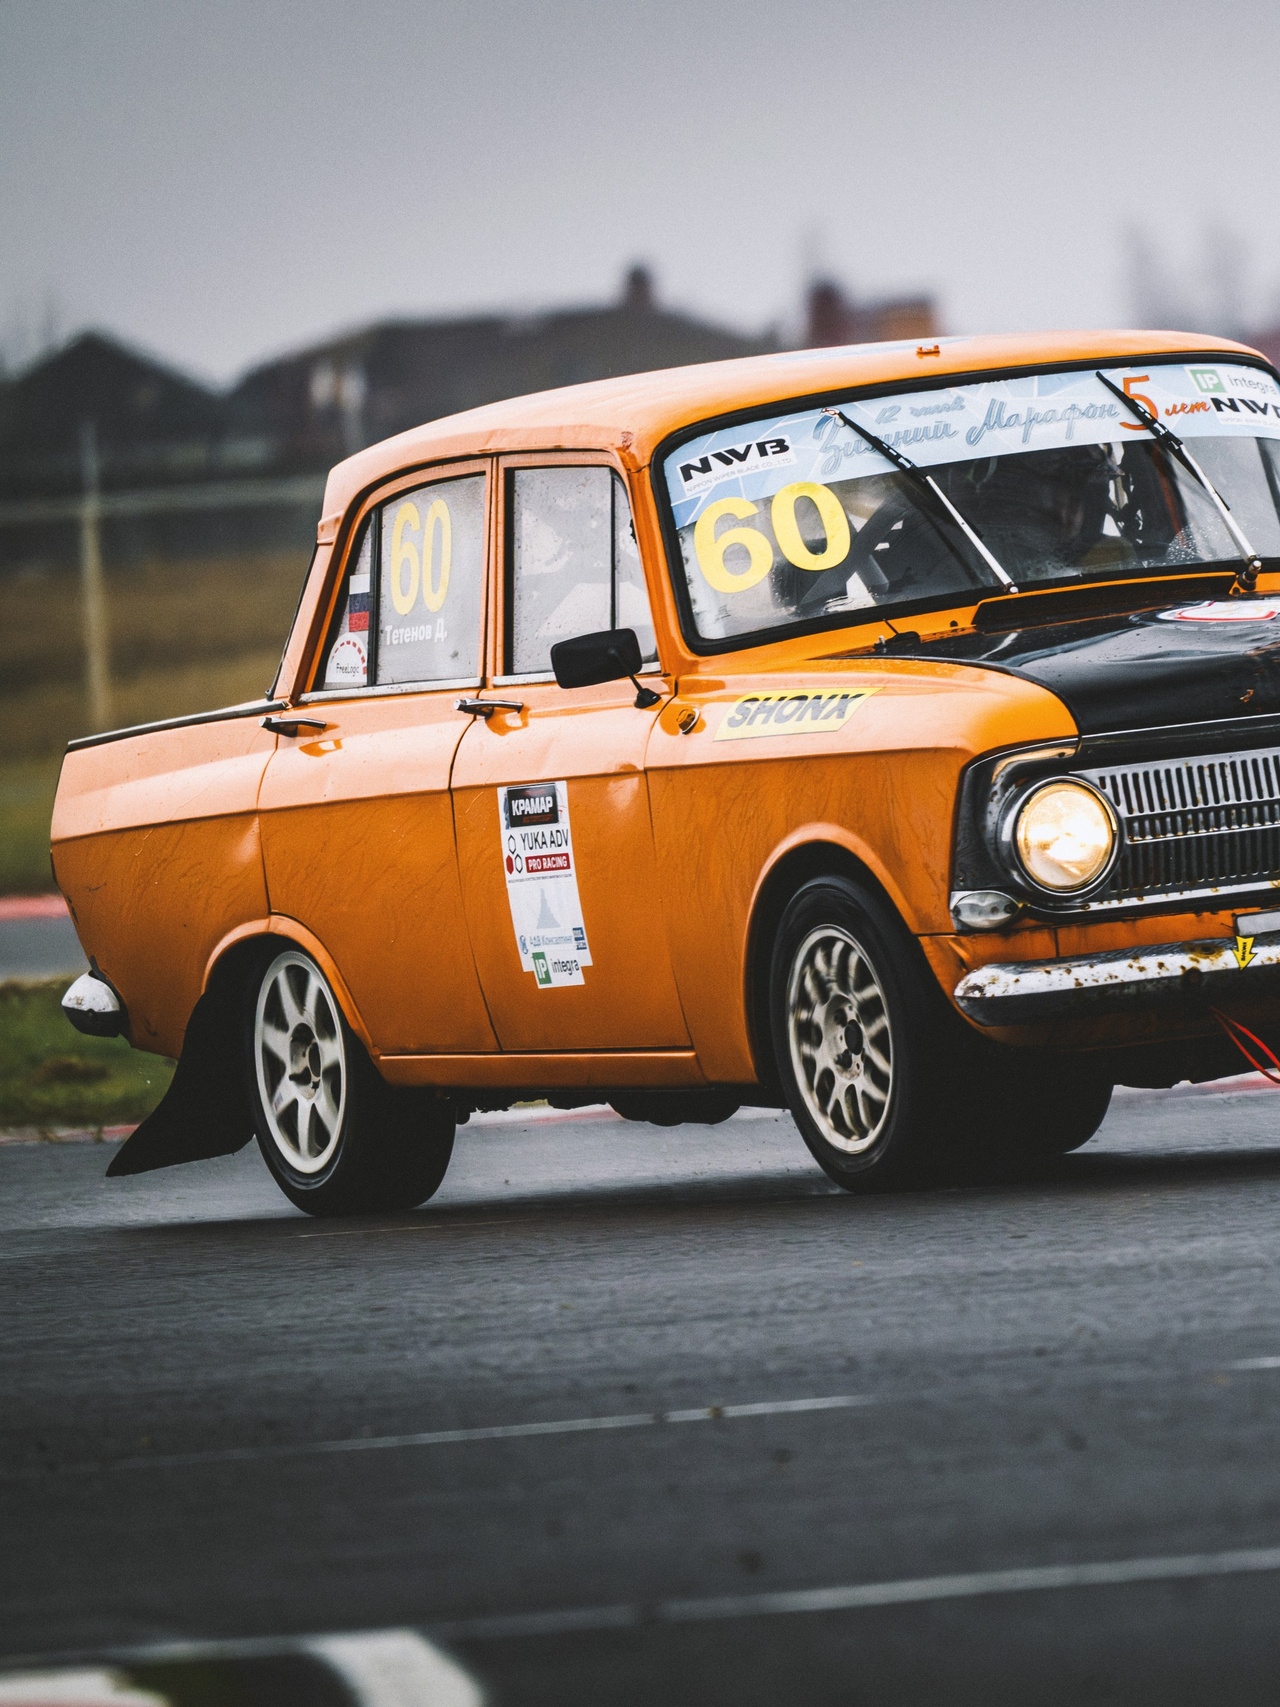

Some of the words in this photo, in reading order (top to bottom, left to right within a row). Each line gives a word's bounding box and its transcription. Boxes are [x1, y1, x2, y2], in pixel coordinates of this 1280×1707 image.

[1119, 375, 1158, 431] 5
[965, 398, 1120, 447] Марафон
[679, 438, 790, 483] NWB
[693, 481, 852, 594] 60
[390, 499, 452, 616] 60
[385, 623, 432, 645] Тетенов
[727, 693, 866, 728] SHONX
[511, 796, 553, 816] КРАМАР
[520, 831, 548, 850] YUKA
[549, 829, 569, 848] ADV
[528, 858, 543, 870] PRO
[542, 855, 568, 868] RACING
[550, 958, 580, 975] integra
